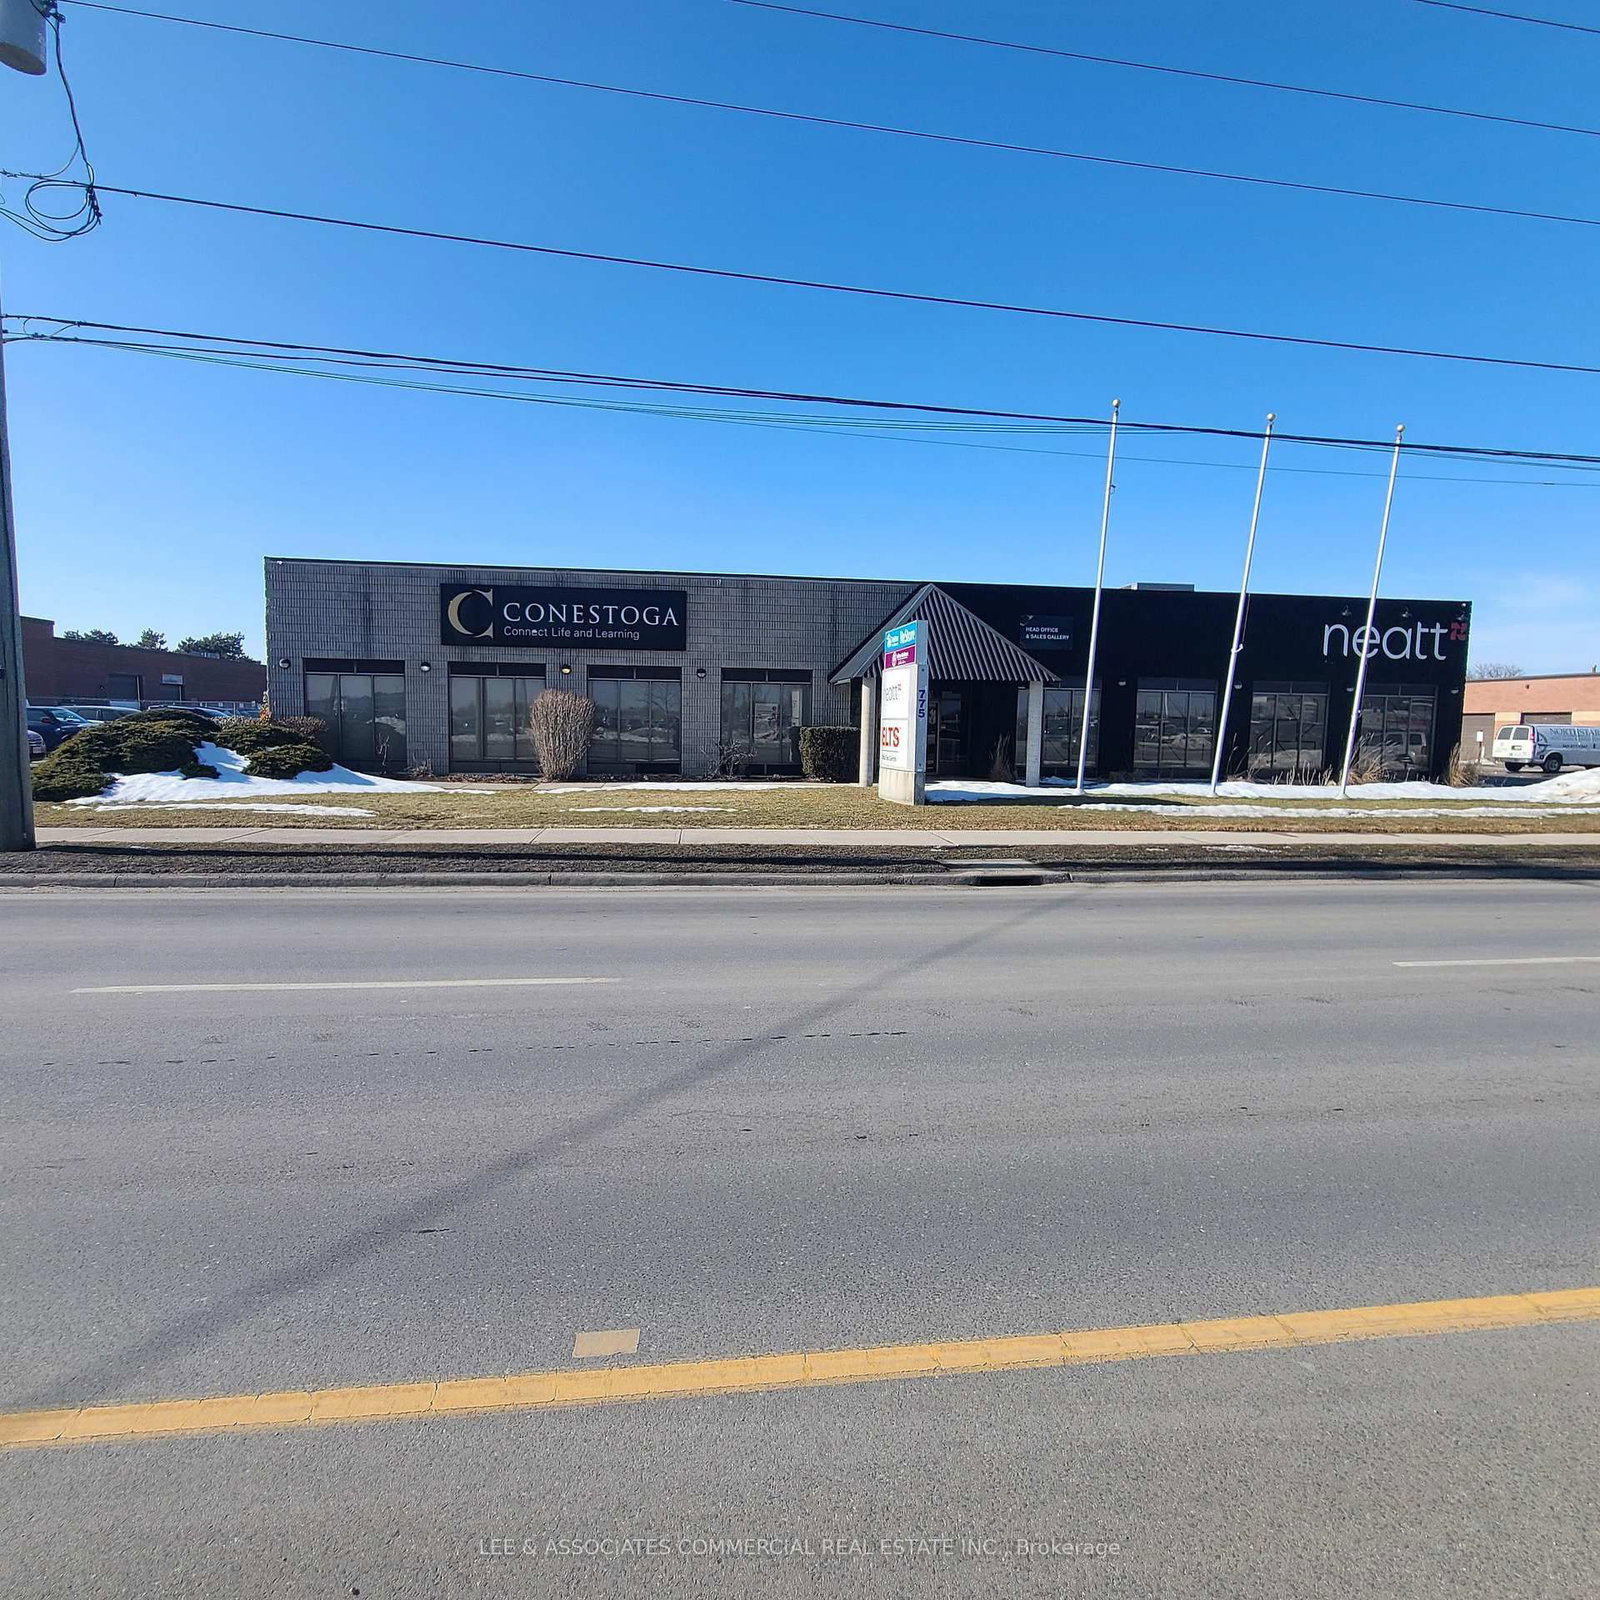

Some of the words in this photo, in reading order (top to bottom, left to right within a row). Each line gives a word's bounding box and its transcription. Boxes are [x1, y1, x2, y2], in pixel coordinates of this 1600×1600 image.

[503, 602, 680, 627] CONESTOGA
[503, 625, 548, 637] Connect
[551, 627, 571, 638] Life
[573, 628, 593, 639] and
[595, 628, 640, 641] Learning
[1322, 621, 1449, 661] neatt
[918, 689, 926, 718] 775
